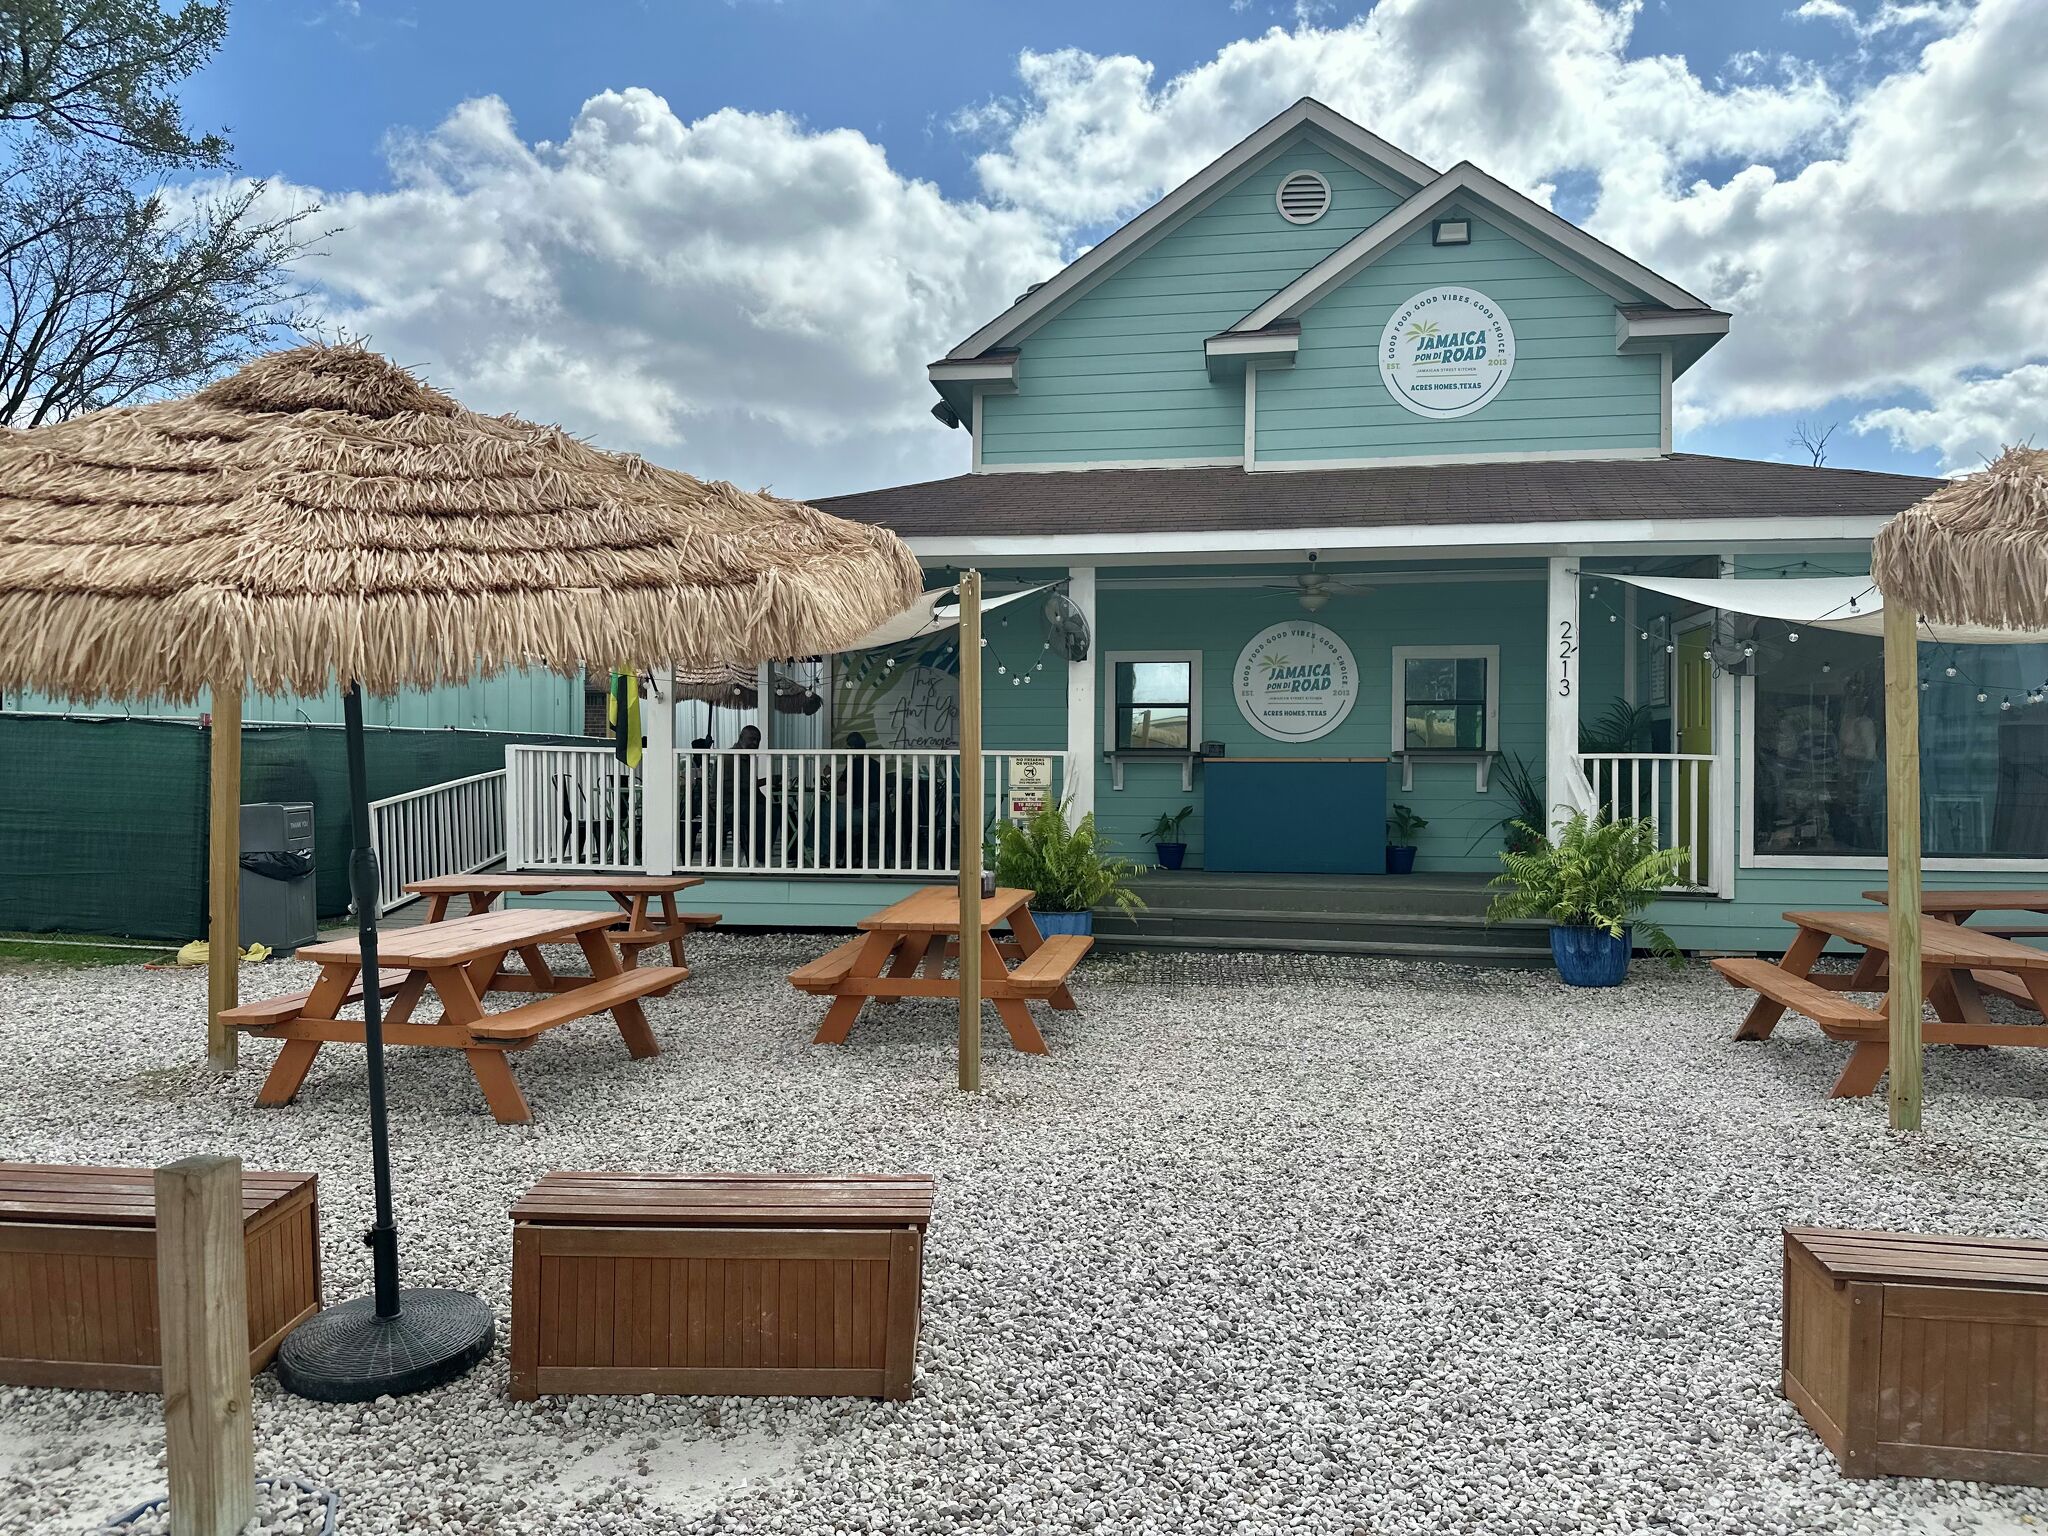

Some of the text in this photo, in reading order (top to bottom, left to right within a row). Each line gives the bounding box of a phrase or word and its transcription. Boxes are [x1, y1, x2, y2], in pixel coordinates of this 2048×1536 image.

[1388, 335, 1398, 359] GOOD
[1414, 296, 1438, 311] GOOD
[1473, 301, 1494, 320] GOOD
[1416, 330, 1487, 352] JAMAICA
[1414, 345, 1487, 364] PON DI ROAD
[1459, 382, 1482, 390] TEXAS
[1243, 665, 1251, 687] GOOD
[1266, 631, 1288, 644] GOOD
[1319, 637, 1338, 655] GOOD
[1558, 620, 1573, 697] 2213
[906, 667, 943, 699] This
[1268, 663, 1332, 681] JAMAICA
[1266, 677, 1332, 693] PON DI ROAD
[889, 695, 960, 733] Ain't Yo
[888, 726, 957, 751] Average
